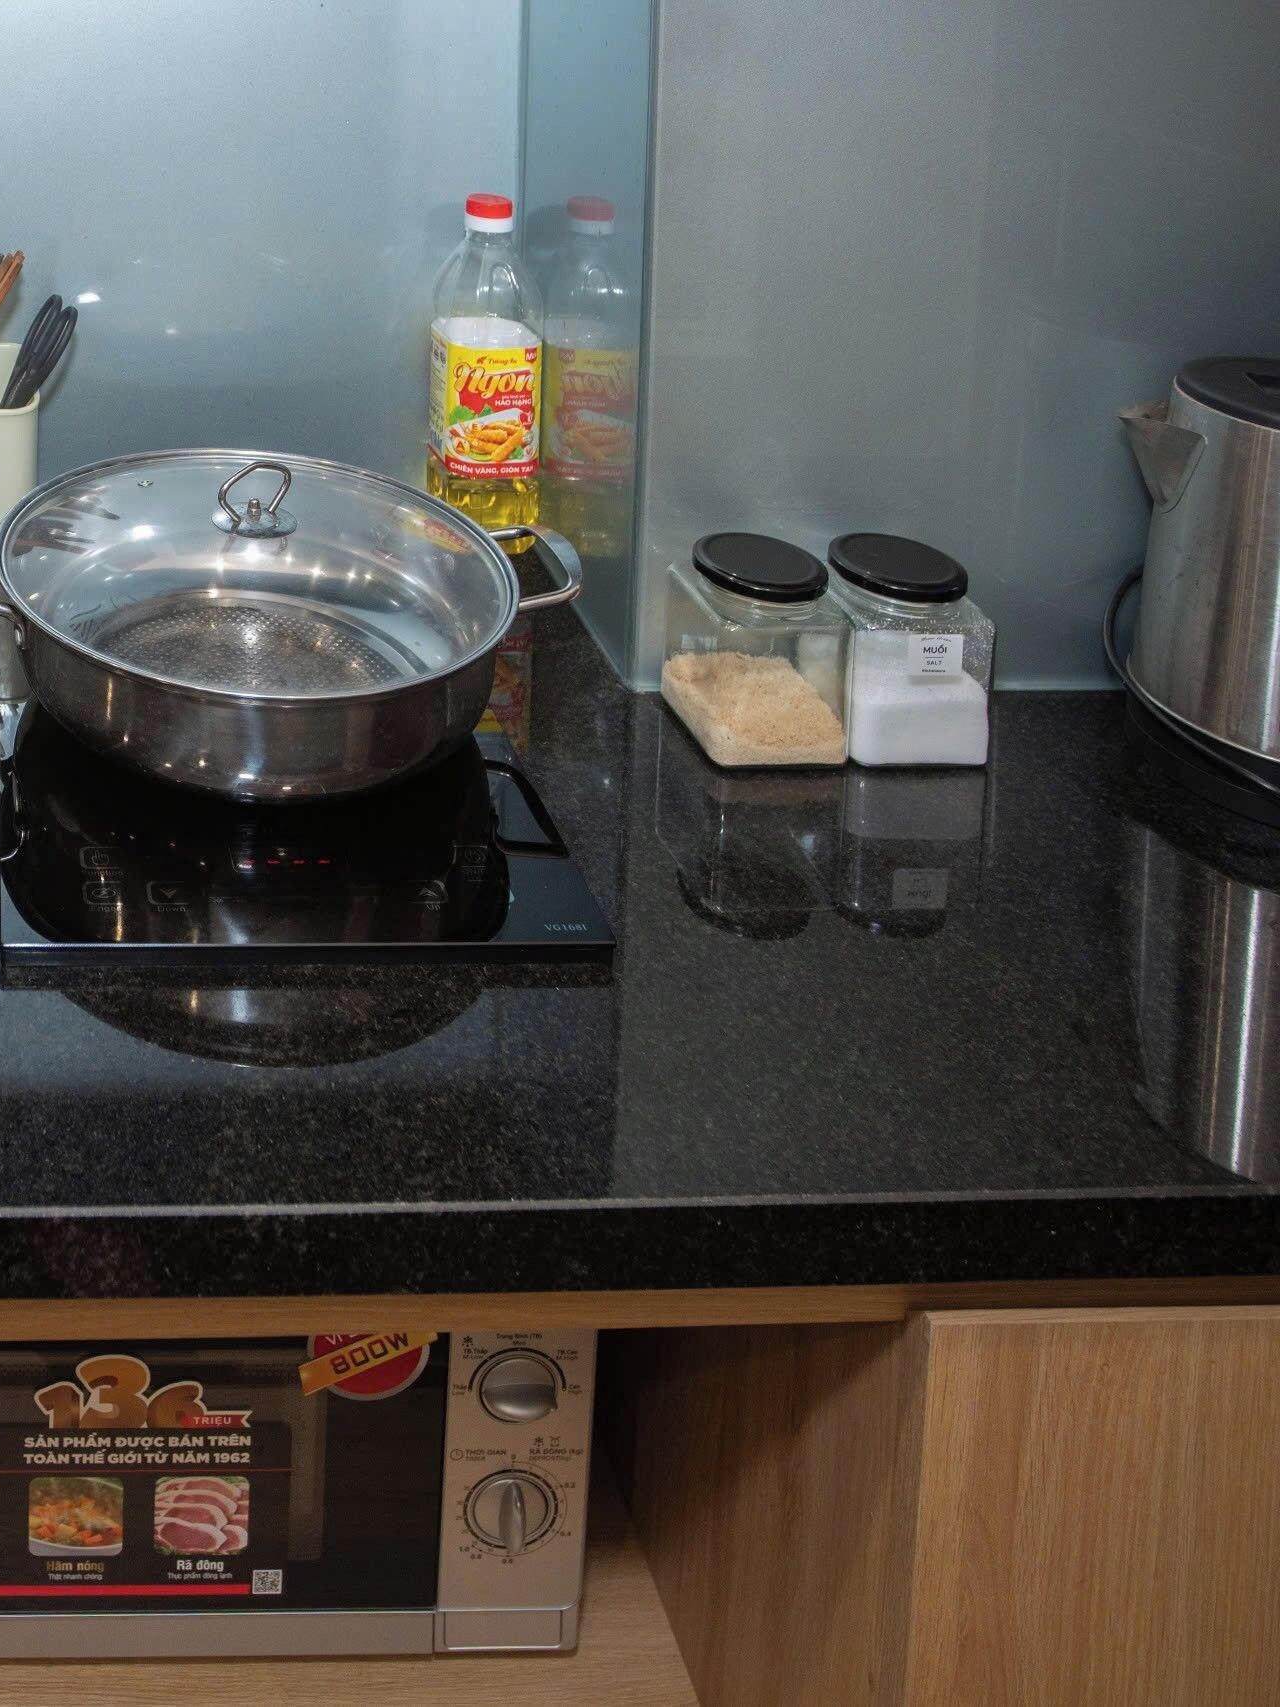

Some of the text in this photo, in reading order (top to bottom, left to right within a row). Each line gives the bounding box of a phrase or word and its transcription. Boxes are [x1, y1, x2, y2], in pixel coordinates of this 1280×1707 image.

[454, 362, 535, 399] Ngon
[331, 1332, 410, 1375] 800W
[24, 1432, 252, 1452] SẢN PHẨM ĐƯỢC BÁN TRÊN
[23, 1449, 251, 1465] TOÀN THẾ GIỚI TỪ NĂM 1962
[76, 1559, 105, 1573] nóng
[176, 1559, 225, 1572] Rã đông
